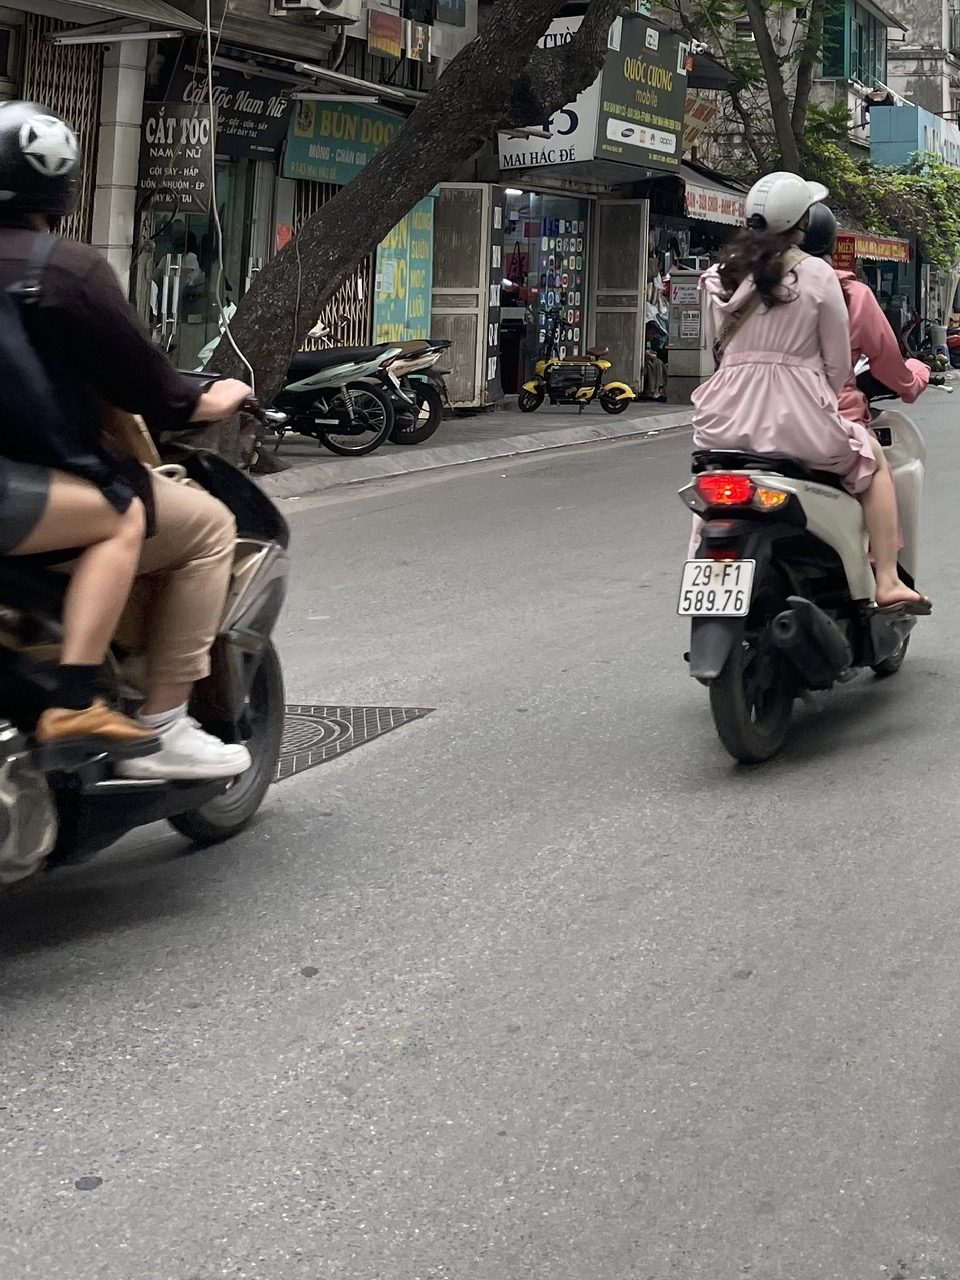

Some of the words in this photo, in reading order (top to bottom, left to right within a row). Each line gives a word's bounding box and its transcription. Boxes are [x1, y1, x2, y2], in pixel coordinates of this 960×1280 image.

[624, 54, 647, 83] QUỐC
[647, 64, 673, 92] CƯỜNG
[212, 85, 233, 109] Tóc
[234, 90, 265, 115] Nam
[265, 96, 288, 118] Nữ
[635, 89, 658, 108] mobile
[145, 106, 177, 144] CẮT
[180, 109, 210, 145] TÓC
[320, 104, 359, 140] BÚN
[361, 118, 395, 152] DỌC
[149, 148, 174, 158] NAM
[185, 146, 202, 158] NỮ
[502, 152, 526, 168] MAI
[529, 145, 557, 165] HẮC
[559, 144, 577, 162] ĐẾ
[804, 485, 840, 500] VISION
[692, 564, 742, 587] 29-F1
[682, 590, 745, 612] 589.76
